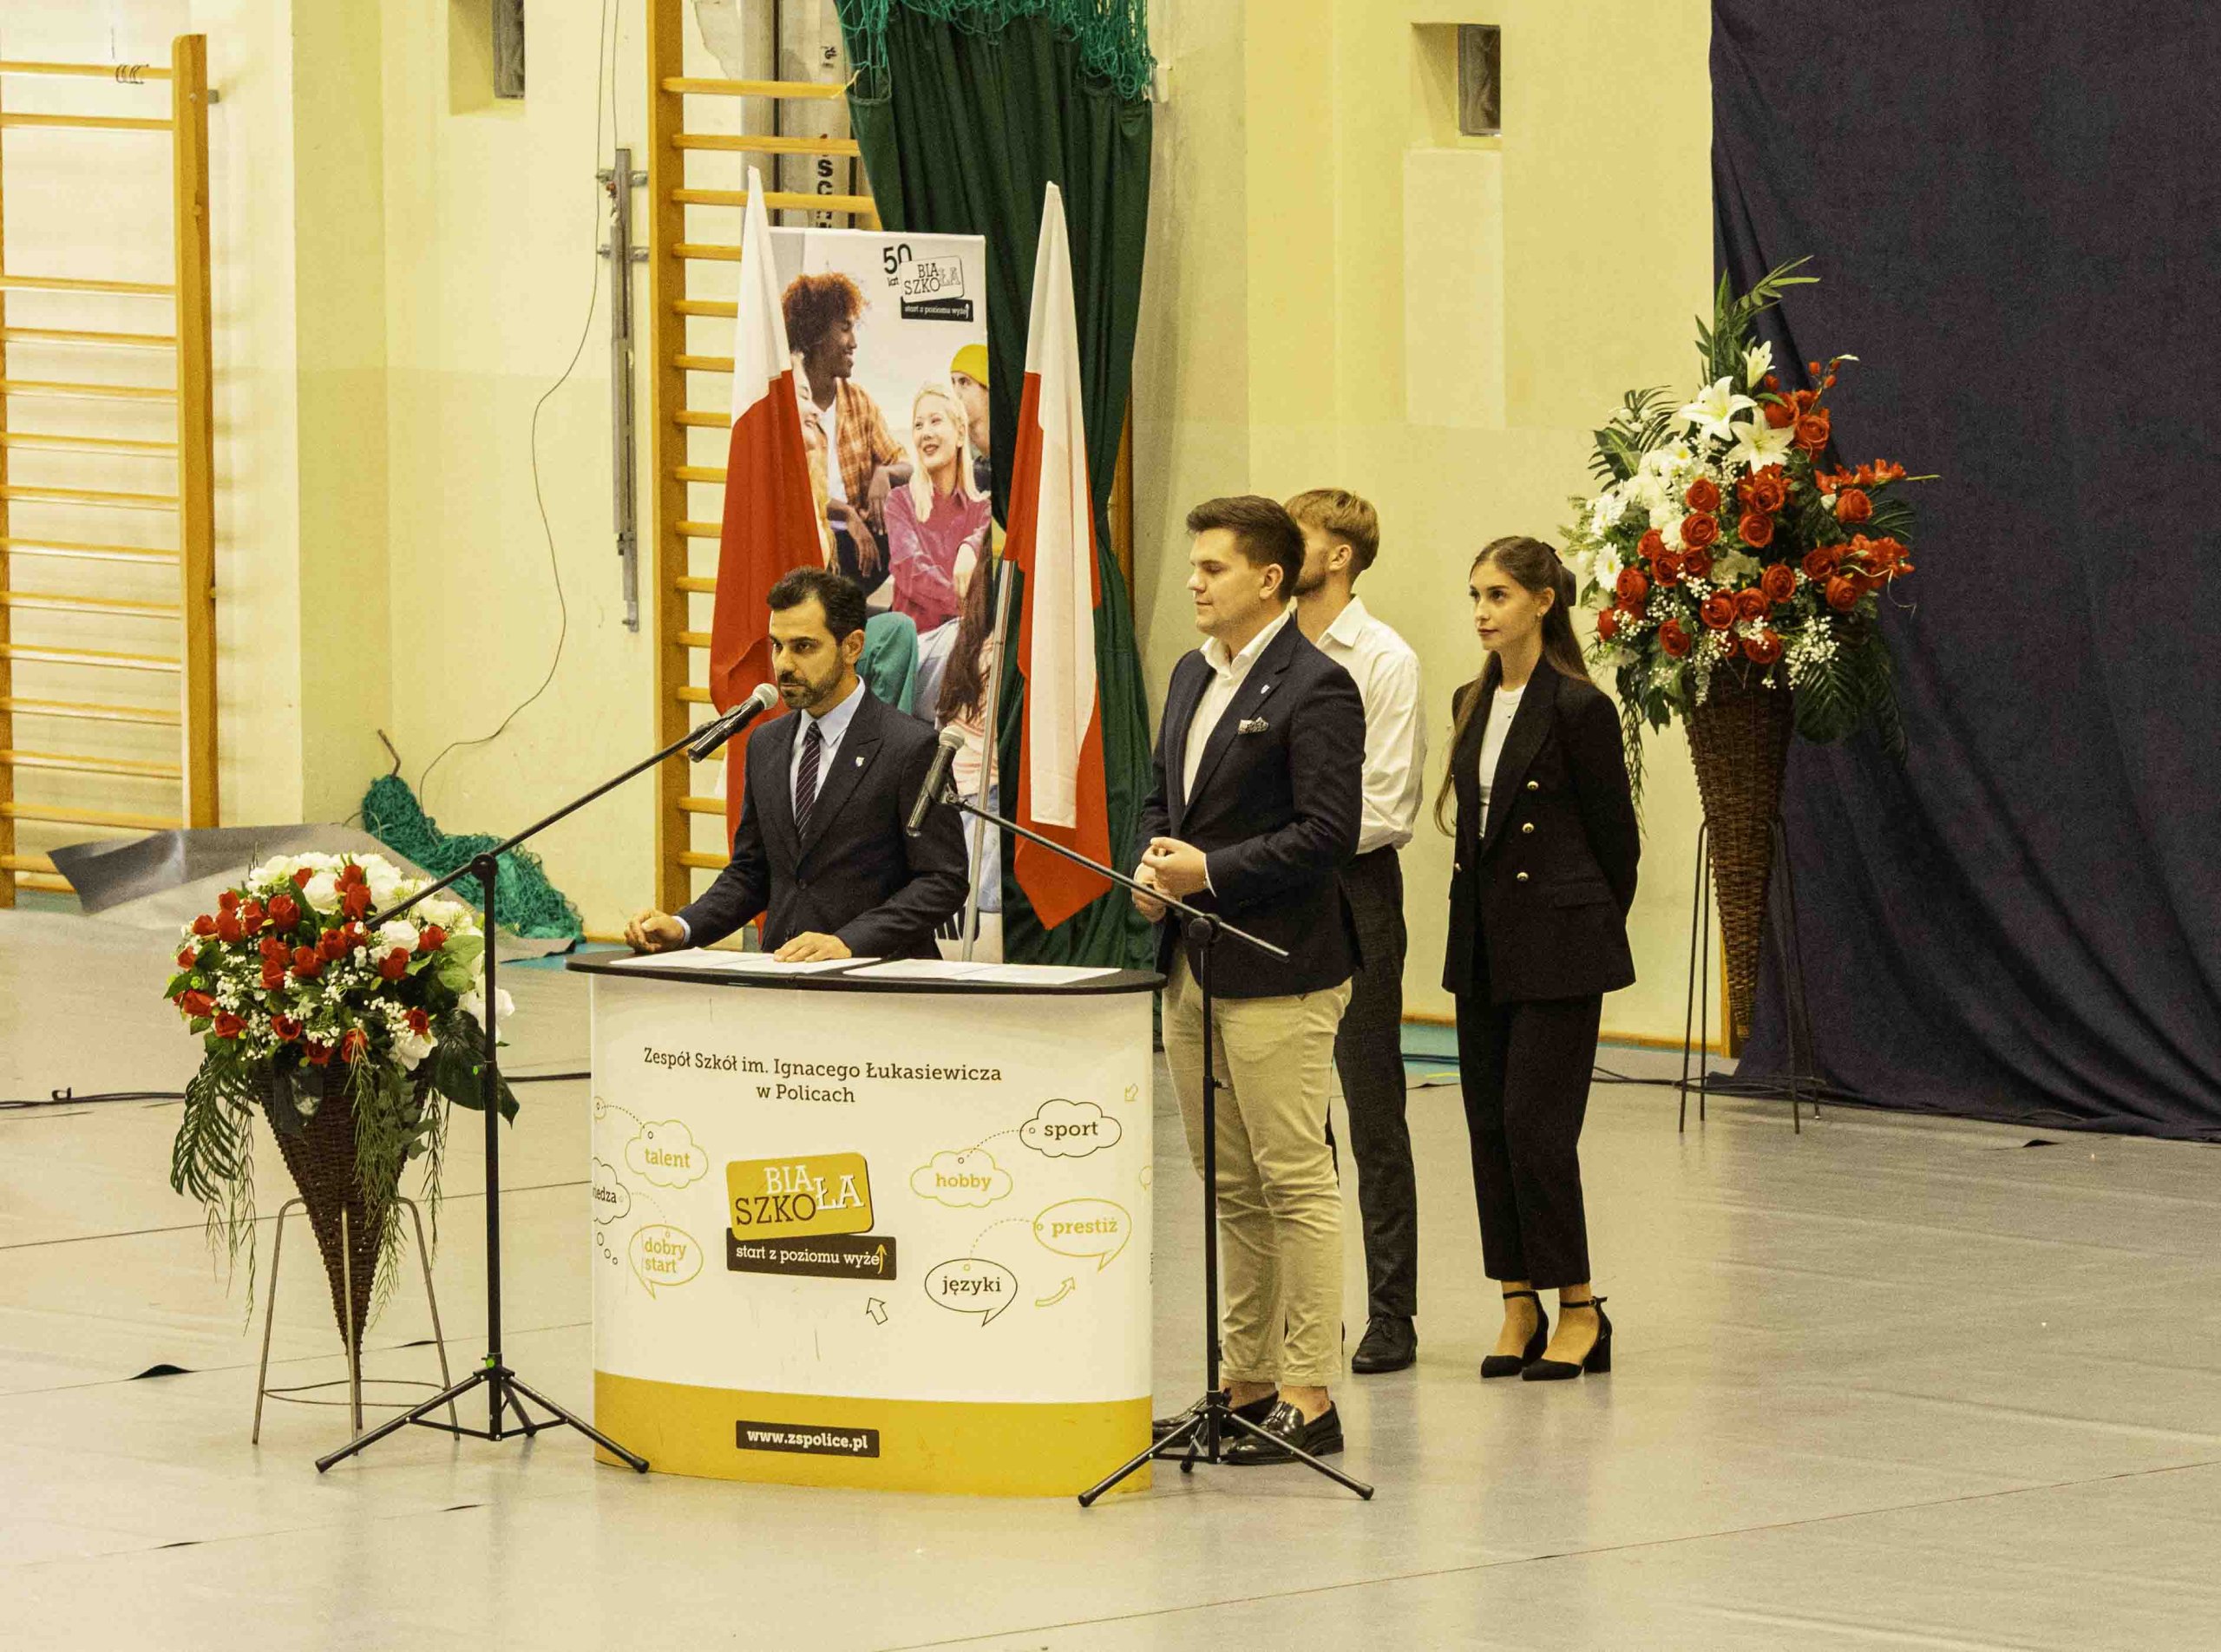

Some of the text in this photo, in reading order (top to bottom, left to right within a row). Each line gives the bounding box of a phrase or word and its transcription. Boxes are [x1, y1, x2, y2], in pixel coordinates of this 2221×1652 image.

[644, 1047, 1002, 1081] Zespół Szkół im. Ignacego Łukasiewicza
[756, 1084, 855, 1103] w Policach
[1044, 1121, 1098, 1140] sport
[644, 1148, 691, 1169] talent
[935, 1173, 993, 1191] hobby
[1052, 1217, 1118, 1238] prestiż
[644, 1237, 686, 1261] dobry
[736, 1244, 765, 1258] start
[769, 1251, 776, 1260] z
[780, 1249, 840, 1264] poziomu
[645, 1257, 677, 1274] start
[942, 1275, 1002, 1295] języki
[746, 1430, 868, 1452] www.zspolice.pl
